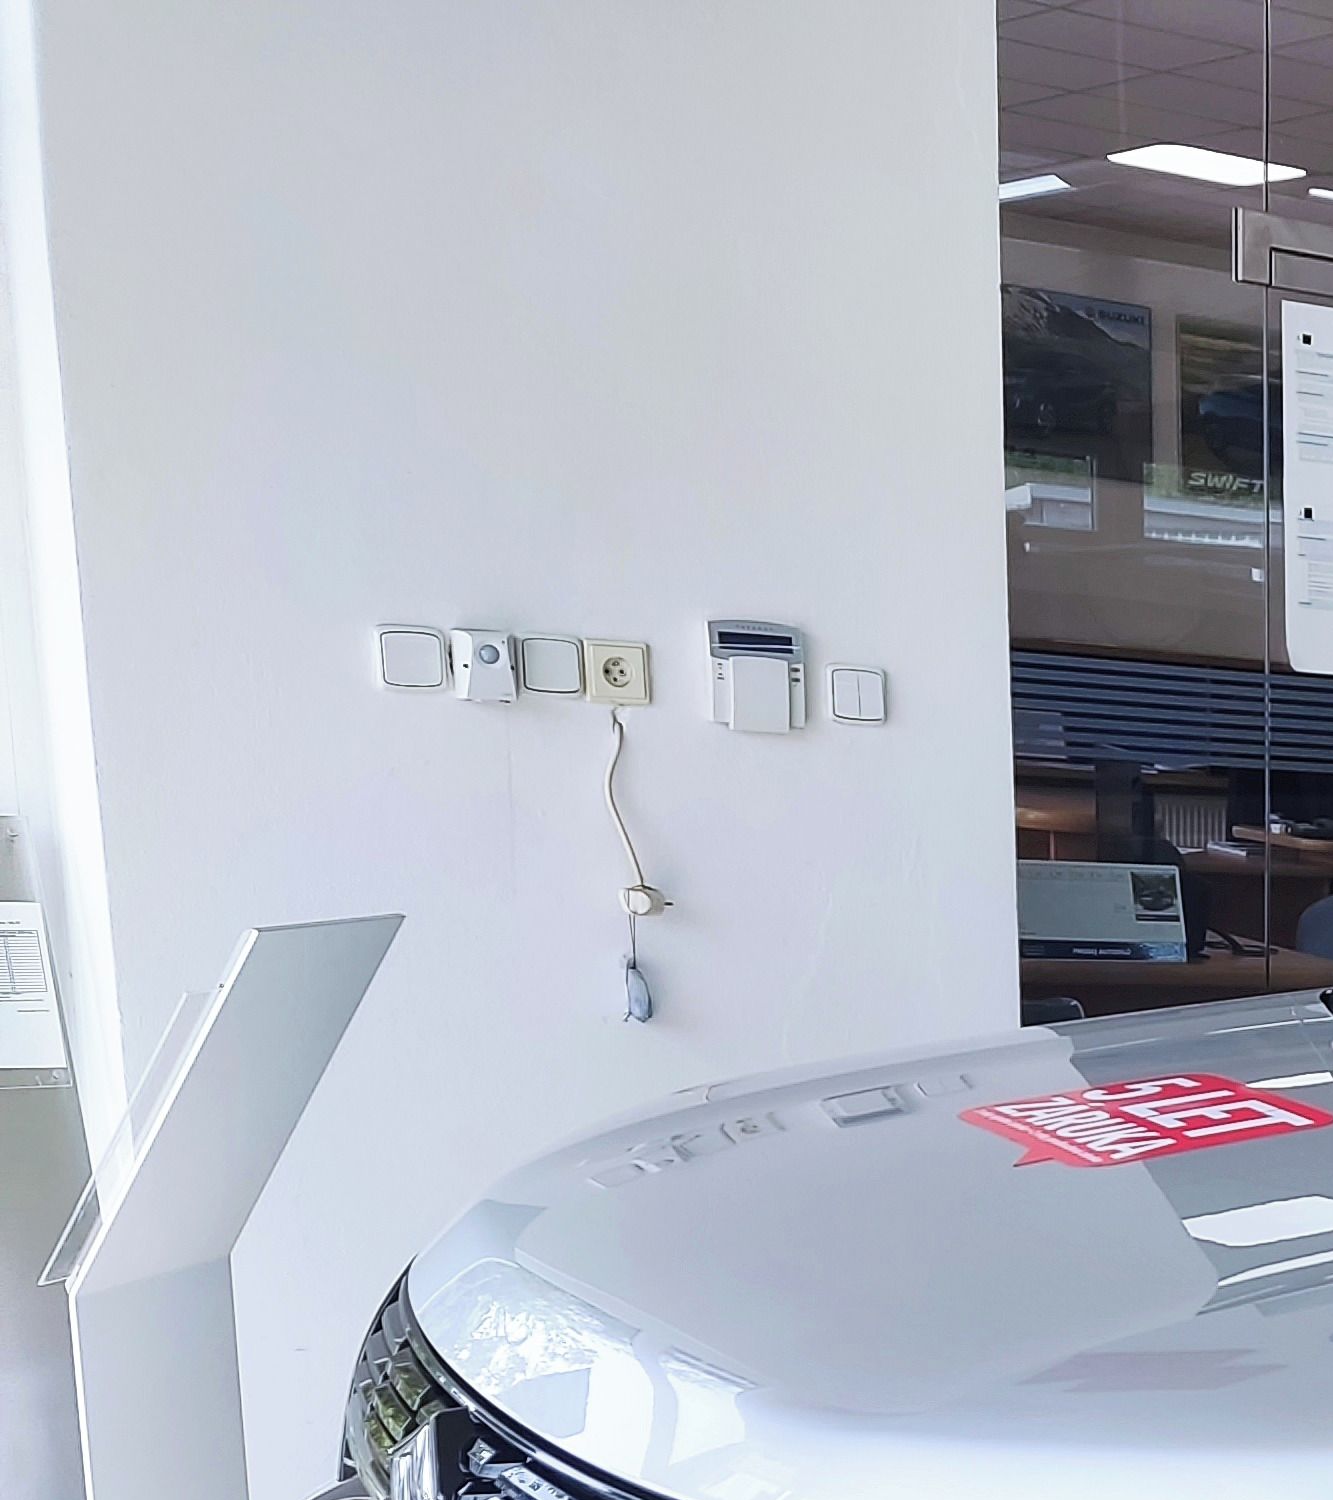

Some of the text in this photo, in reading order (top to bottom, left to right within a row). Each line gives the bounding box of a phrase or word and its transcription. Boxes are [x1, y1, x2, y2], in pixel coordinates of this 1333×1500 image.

[1098, 310, 1145, 325] SUZUKI
[1188, 472, 1264, 493] SWIFT
[993, 1096, 1178, 1161] ZÁRUKA
[1120, 1089, 1315, 1139] LET
